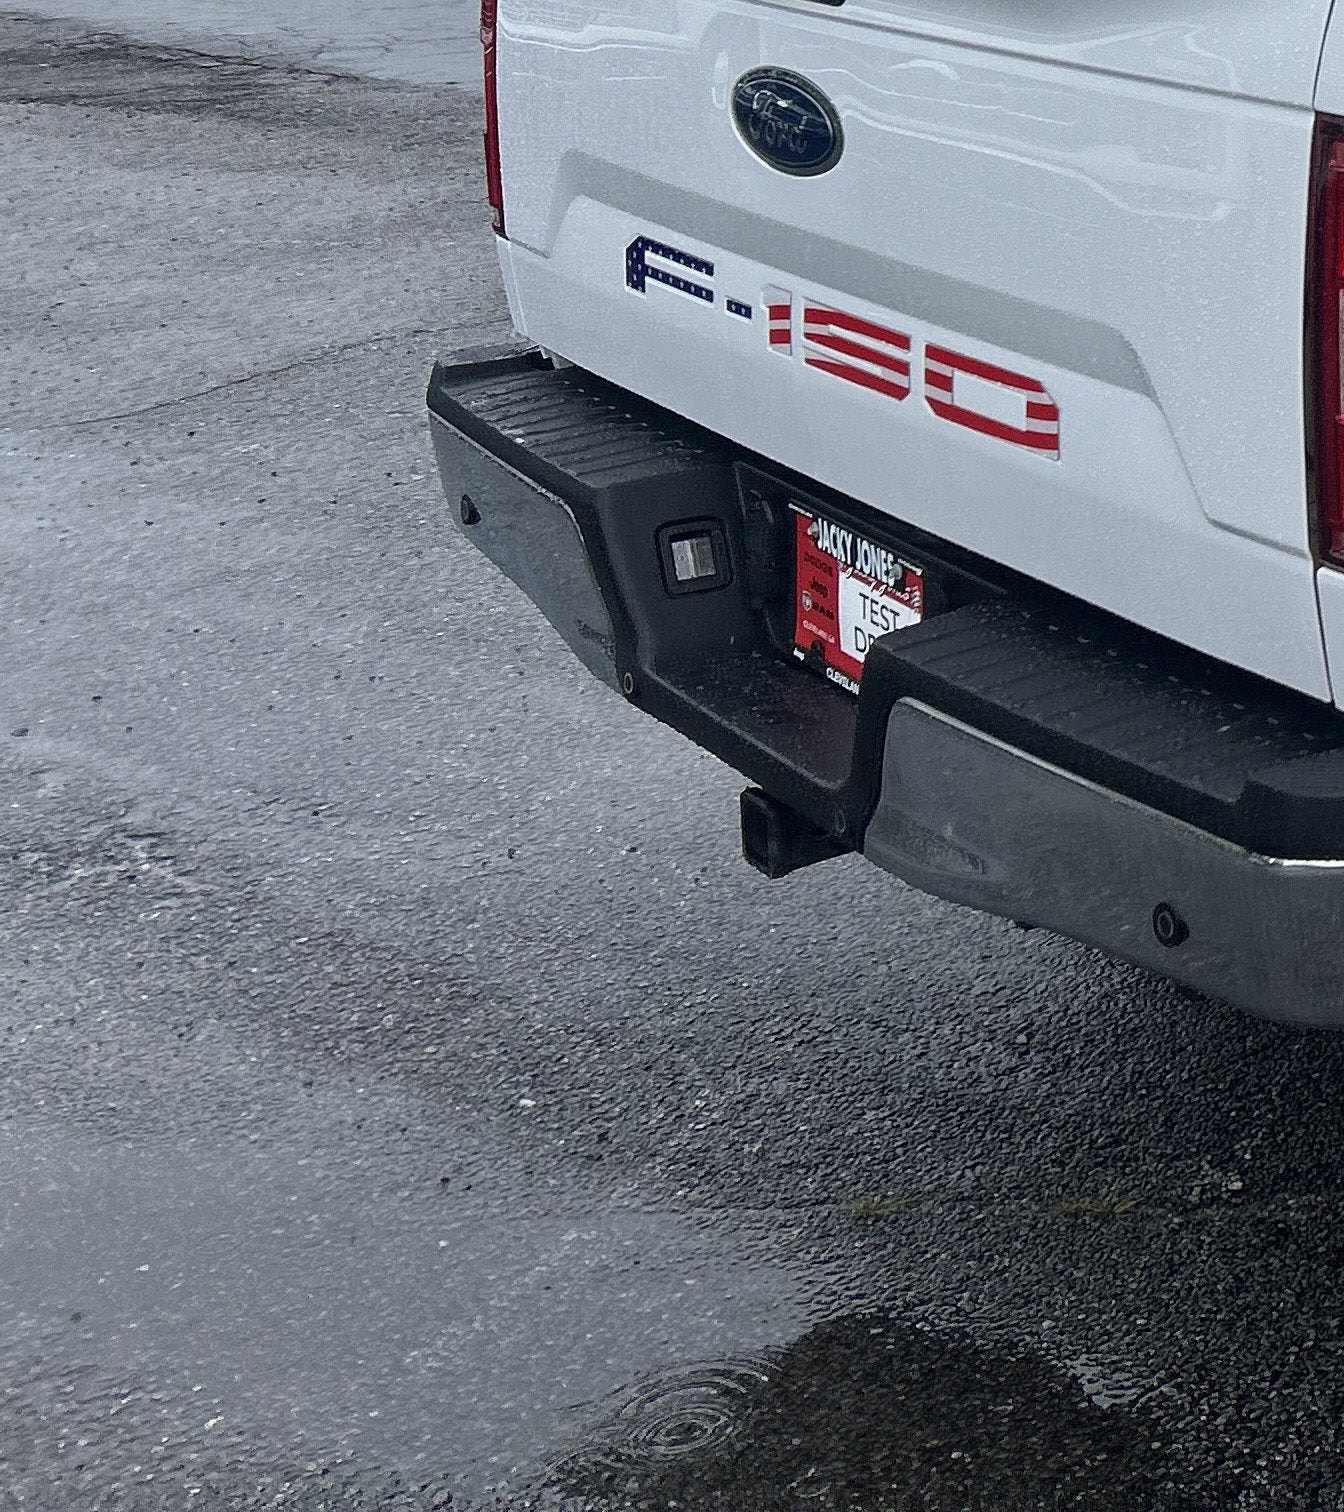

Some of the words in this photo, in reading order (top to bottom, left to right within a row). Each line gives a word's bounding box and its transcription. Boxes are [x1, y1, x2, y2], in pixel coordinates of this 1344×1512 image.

[625, 234, 1061, 462] F-150
[817, 517, 853, 566] JACKY
[855, 537, 895, 587] JONES
[858, 592, 900, 632] TEST
[826, 666, 860, 696] CLEVELAN
